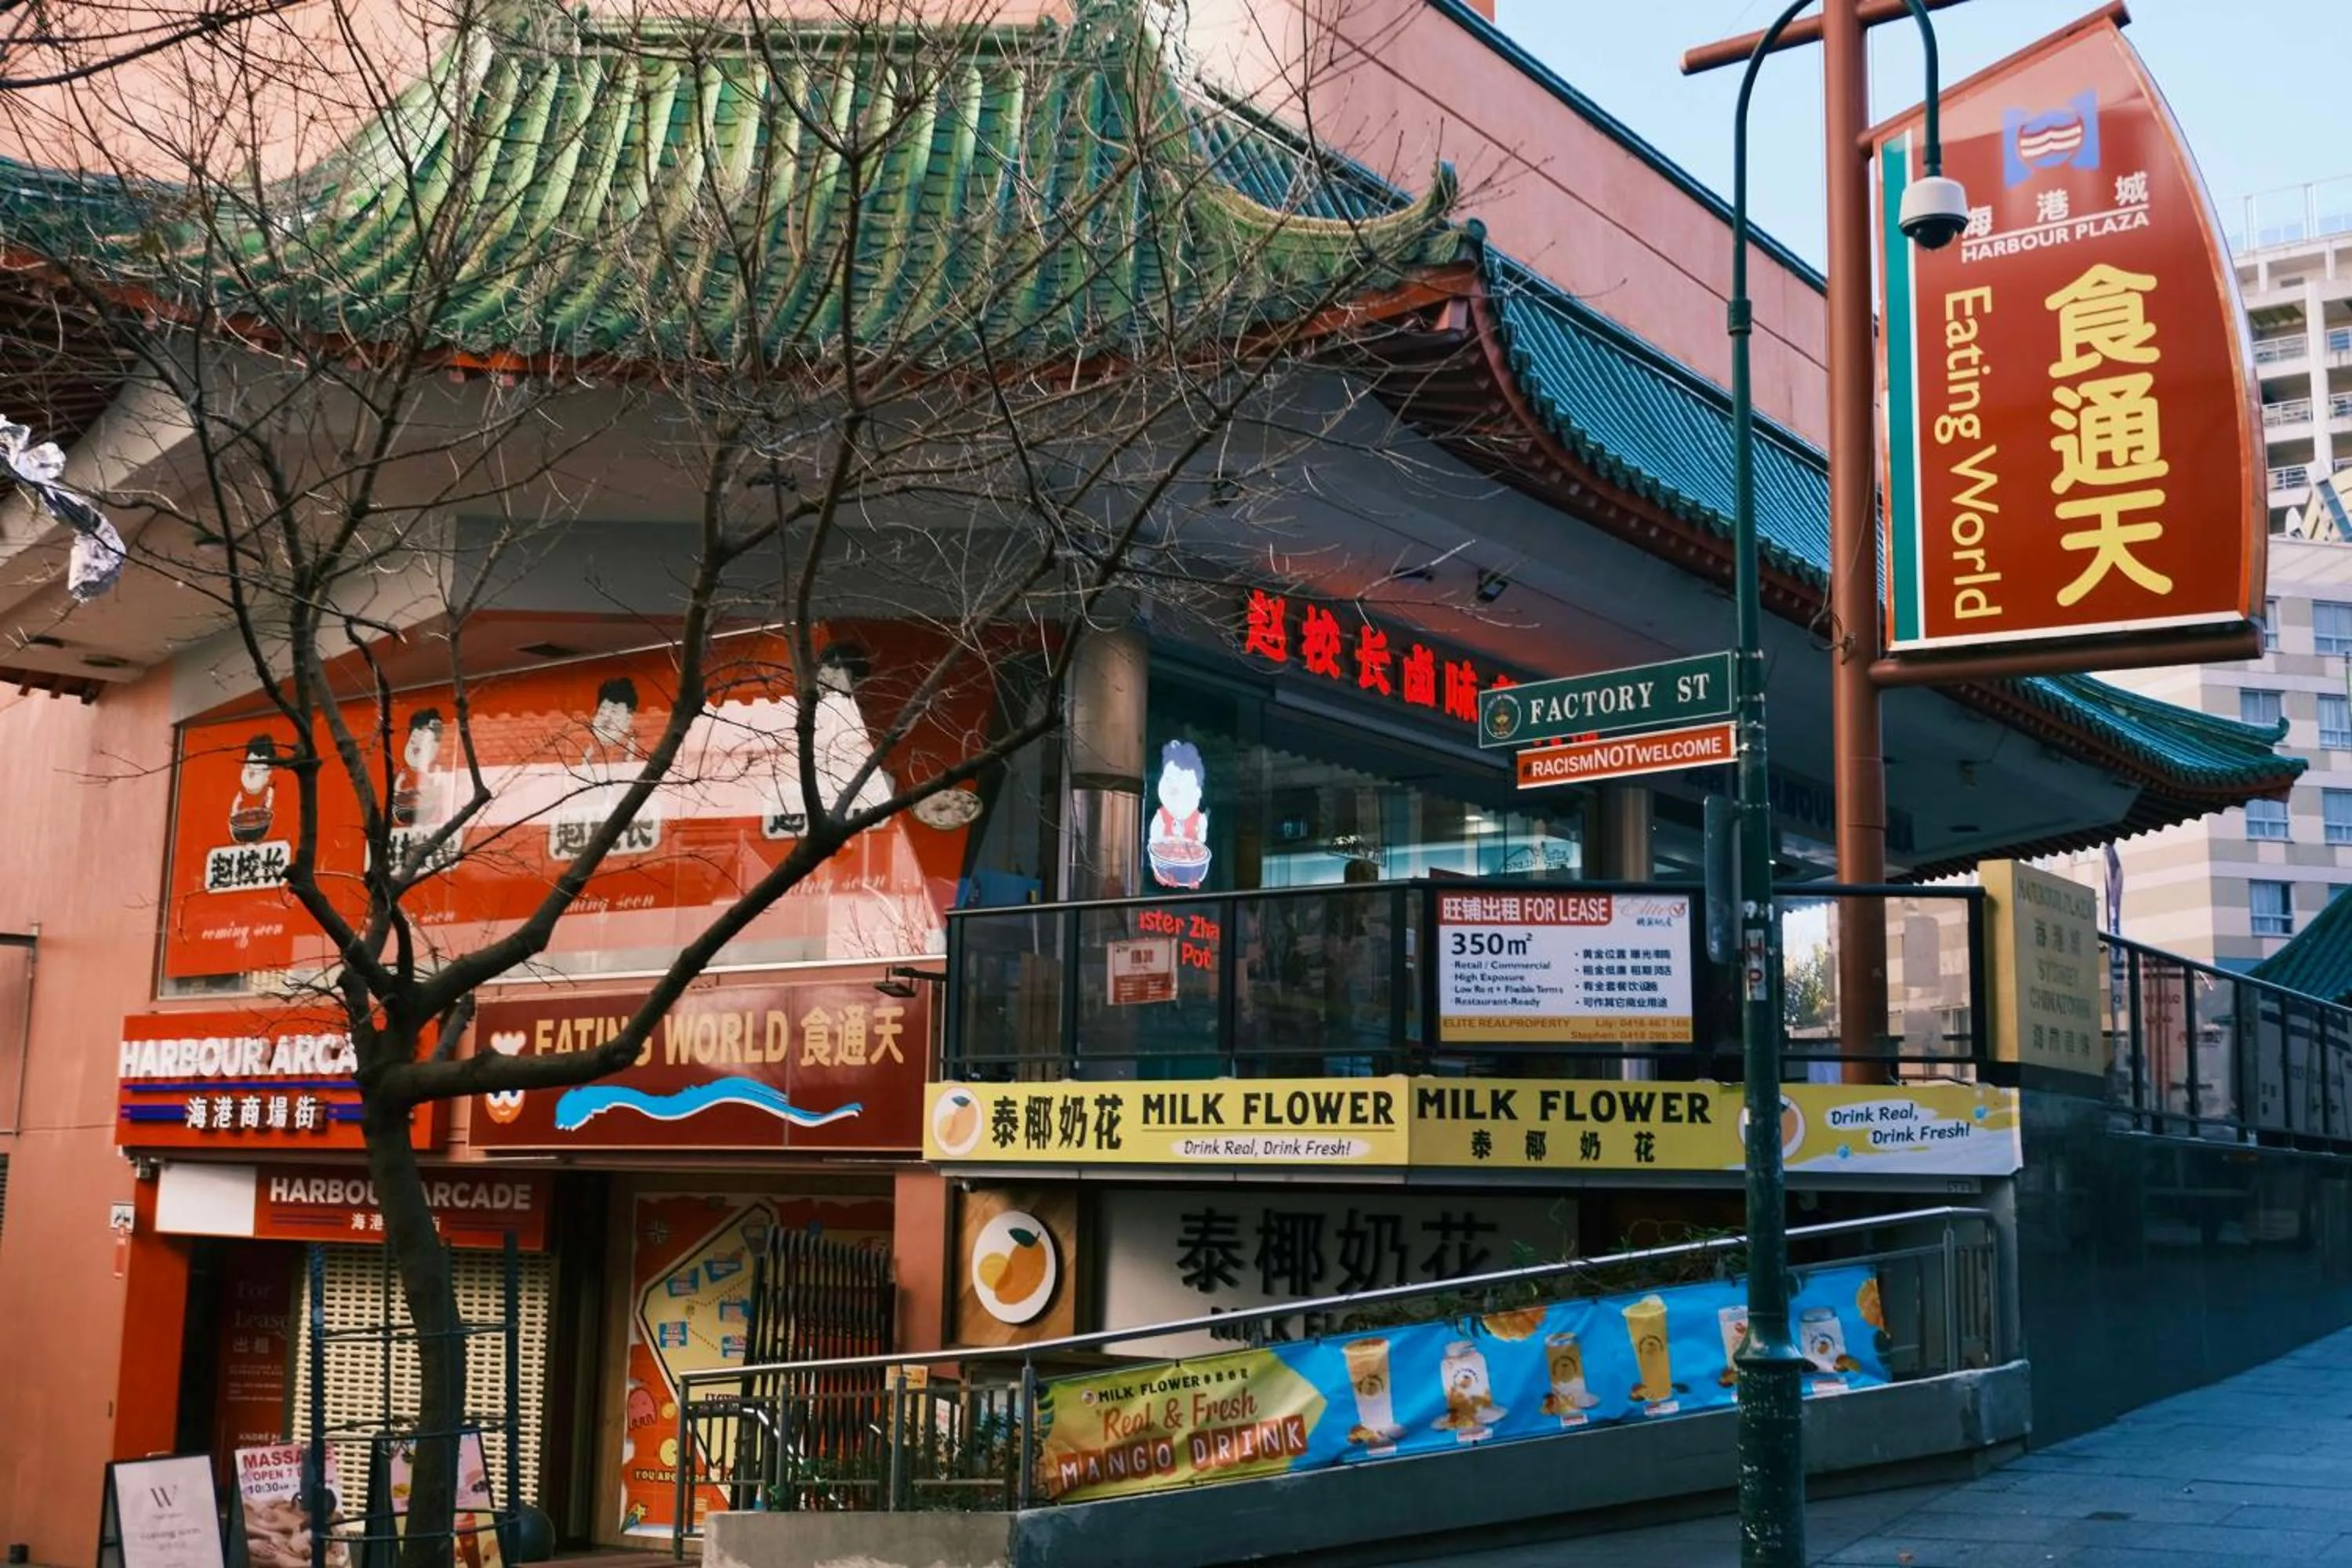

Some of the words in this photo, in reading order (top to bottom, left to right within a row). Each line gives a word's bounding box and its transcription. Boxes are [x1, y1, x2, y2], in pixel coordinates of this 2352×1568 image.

[1962, 171, 2150, 238] 海港城
[1961, 227, 2070, 263] HARBOUR
[2075, 210, 2151, 240] PLAZA
[1933, 285, 1993, 445] Eating
[2044, 263, 2174, 608] 食通天
[1950, 445, 2003, 621] World
[1243, 588, 1523, 724] 赵校长卤味
[1529, 681, 1655, 724] FACTORY
[1676, 673, 1711, 703] ST
[554, 815, 652, 855] 赵长
[209, 847, 285, 888] 赵校长
[1139, 910, 1185, 935] ister
[1189, 915, 1220, 939] Zha
[1524, 898, 1555, 921] FOR
[1559, 898, 1609, 922] LEASE
[201, 920, 250, 949] coming
[253, 922, 284, 937] soon
[1181, 941, 1211, 968] Pot
[1490, 961, 1551, 970] Commercial
[1454, 973, 1478, 982] High
[1480, 974, 1525, 982] Exposure
[1454, 997, 1541, 1007] Restaurant-Ready
[663, 1009, 789, 1065] WORLD
[800, 1005, 906, 1067] 食通天
[118, 1036, 270, 1079] HARBOUR
[270, 1033, 358, 1074] ARCA
[186, 1094, 318, 1131] 海港商場街
[990, 1094, 1124, 1151] 泰椰奶花
[1141, 1092, 1223, 1126] MILK
[1242, 1091, 1396, 1126] FLOWER
[1416, 1088, 1519, 1121] MILK
[1539, 1091, 1712, 1125] FLOWER
[1830, 1105, 1877, 1126] Drink
[1878, 1102, 1919, 1125] Real,
[1184, 1138, 1220, 1156] Drink
[1223, 1138, 1259, 1158] Real,
[1263, 1138, 1301, 1156] Drink
[1305, 1138, 1352, 1156] Fresh!
[1471, 1128, 1657, 1164] 泰椰奶花
[1871, 1124, 1915, 1145] Drink
[1919, 1121, 1972, 1142] Fresh!
[270, 1178, 379, 1207] HARBOU
[1175, 1207, 1499, 1295] 泰椰奶花
[1098, 1386, 1134, 1403] MILK
[1141, 1375, 1200, 1396] FLOWER
[1103, 1405, 1155, 1442] Real
[1163, 1397, 1185, 1430] &
[1192, 1386, 1257, 1426] Fresh
[1060, 1443, 1174, 1490] MANGO
[1192, 1414, 1305, 1465] DRINK
[253, 1469, 283, 1482] OPEN
